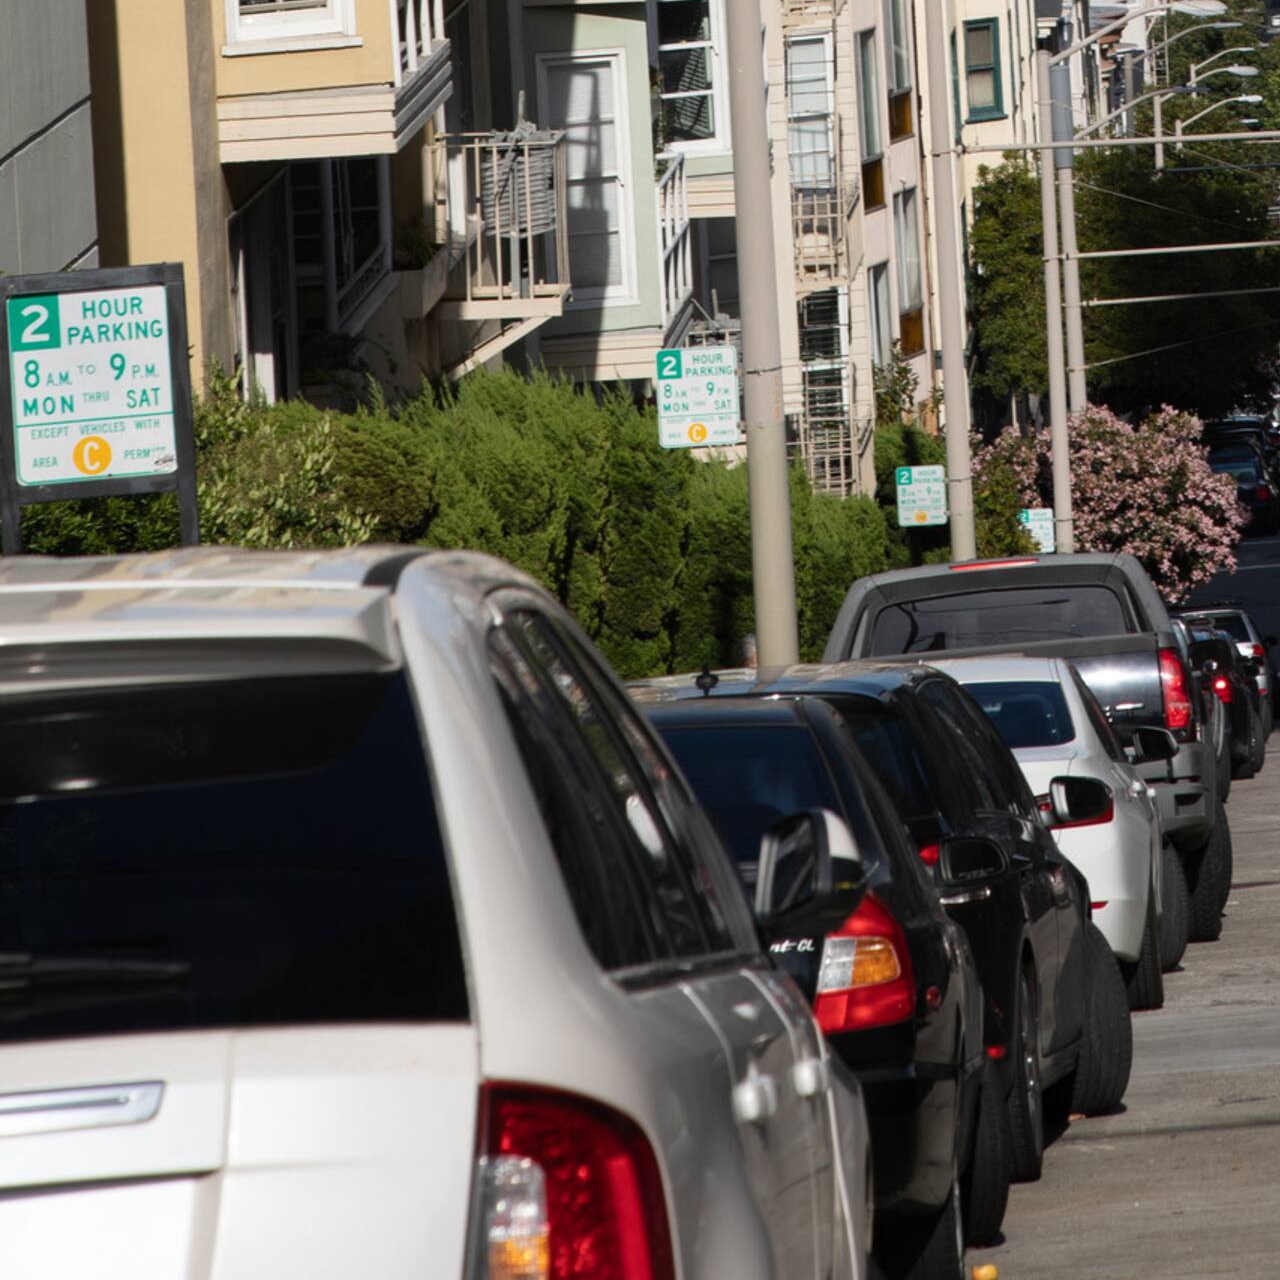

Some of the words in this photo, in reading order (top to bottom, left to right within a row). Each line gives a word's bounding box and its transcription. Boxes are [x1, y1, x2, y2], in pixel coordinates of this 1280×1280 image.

[20, 304, 50, 343] 2
[82, 296, 143, 319] HOUR
[67, 319, 163, 345] PARKING
[24, 359, 40, 388] 8
[78, 364, 96, 375] TO
[109, 353, 126, 381] 9
[662, 356, 677, 376] 2
[692, 353, 723, 364] HOUR
[685, 365, 733, 376] PARKING
[664, 384, 672, 398] 8
[706, 381, 715, 395] 9
[23, 395, 75, 417] MON
[83, 392, 110, 403] THRU
[126, 387, 161, 409] SAT
[663, 403, 689, 412] MON
[714, 400, 731, 410] SAT
[31, 426, 69, 440] EXCEPT
[79, 421, 126, 435] VEHICLES
[134, 419, 160, 430] WITH
[33, 456, 58, 468] AREA
[83, 442, 101, 470] C
[900, 471, 909, 483] 2
[797, 938, 816, 952] GL
